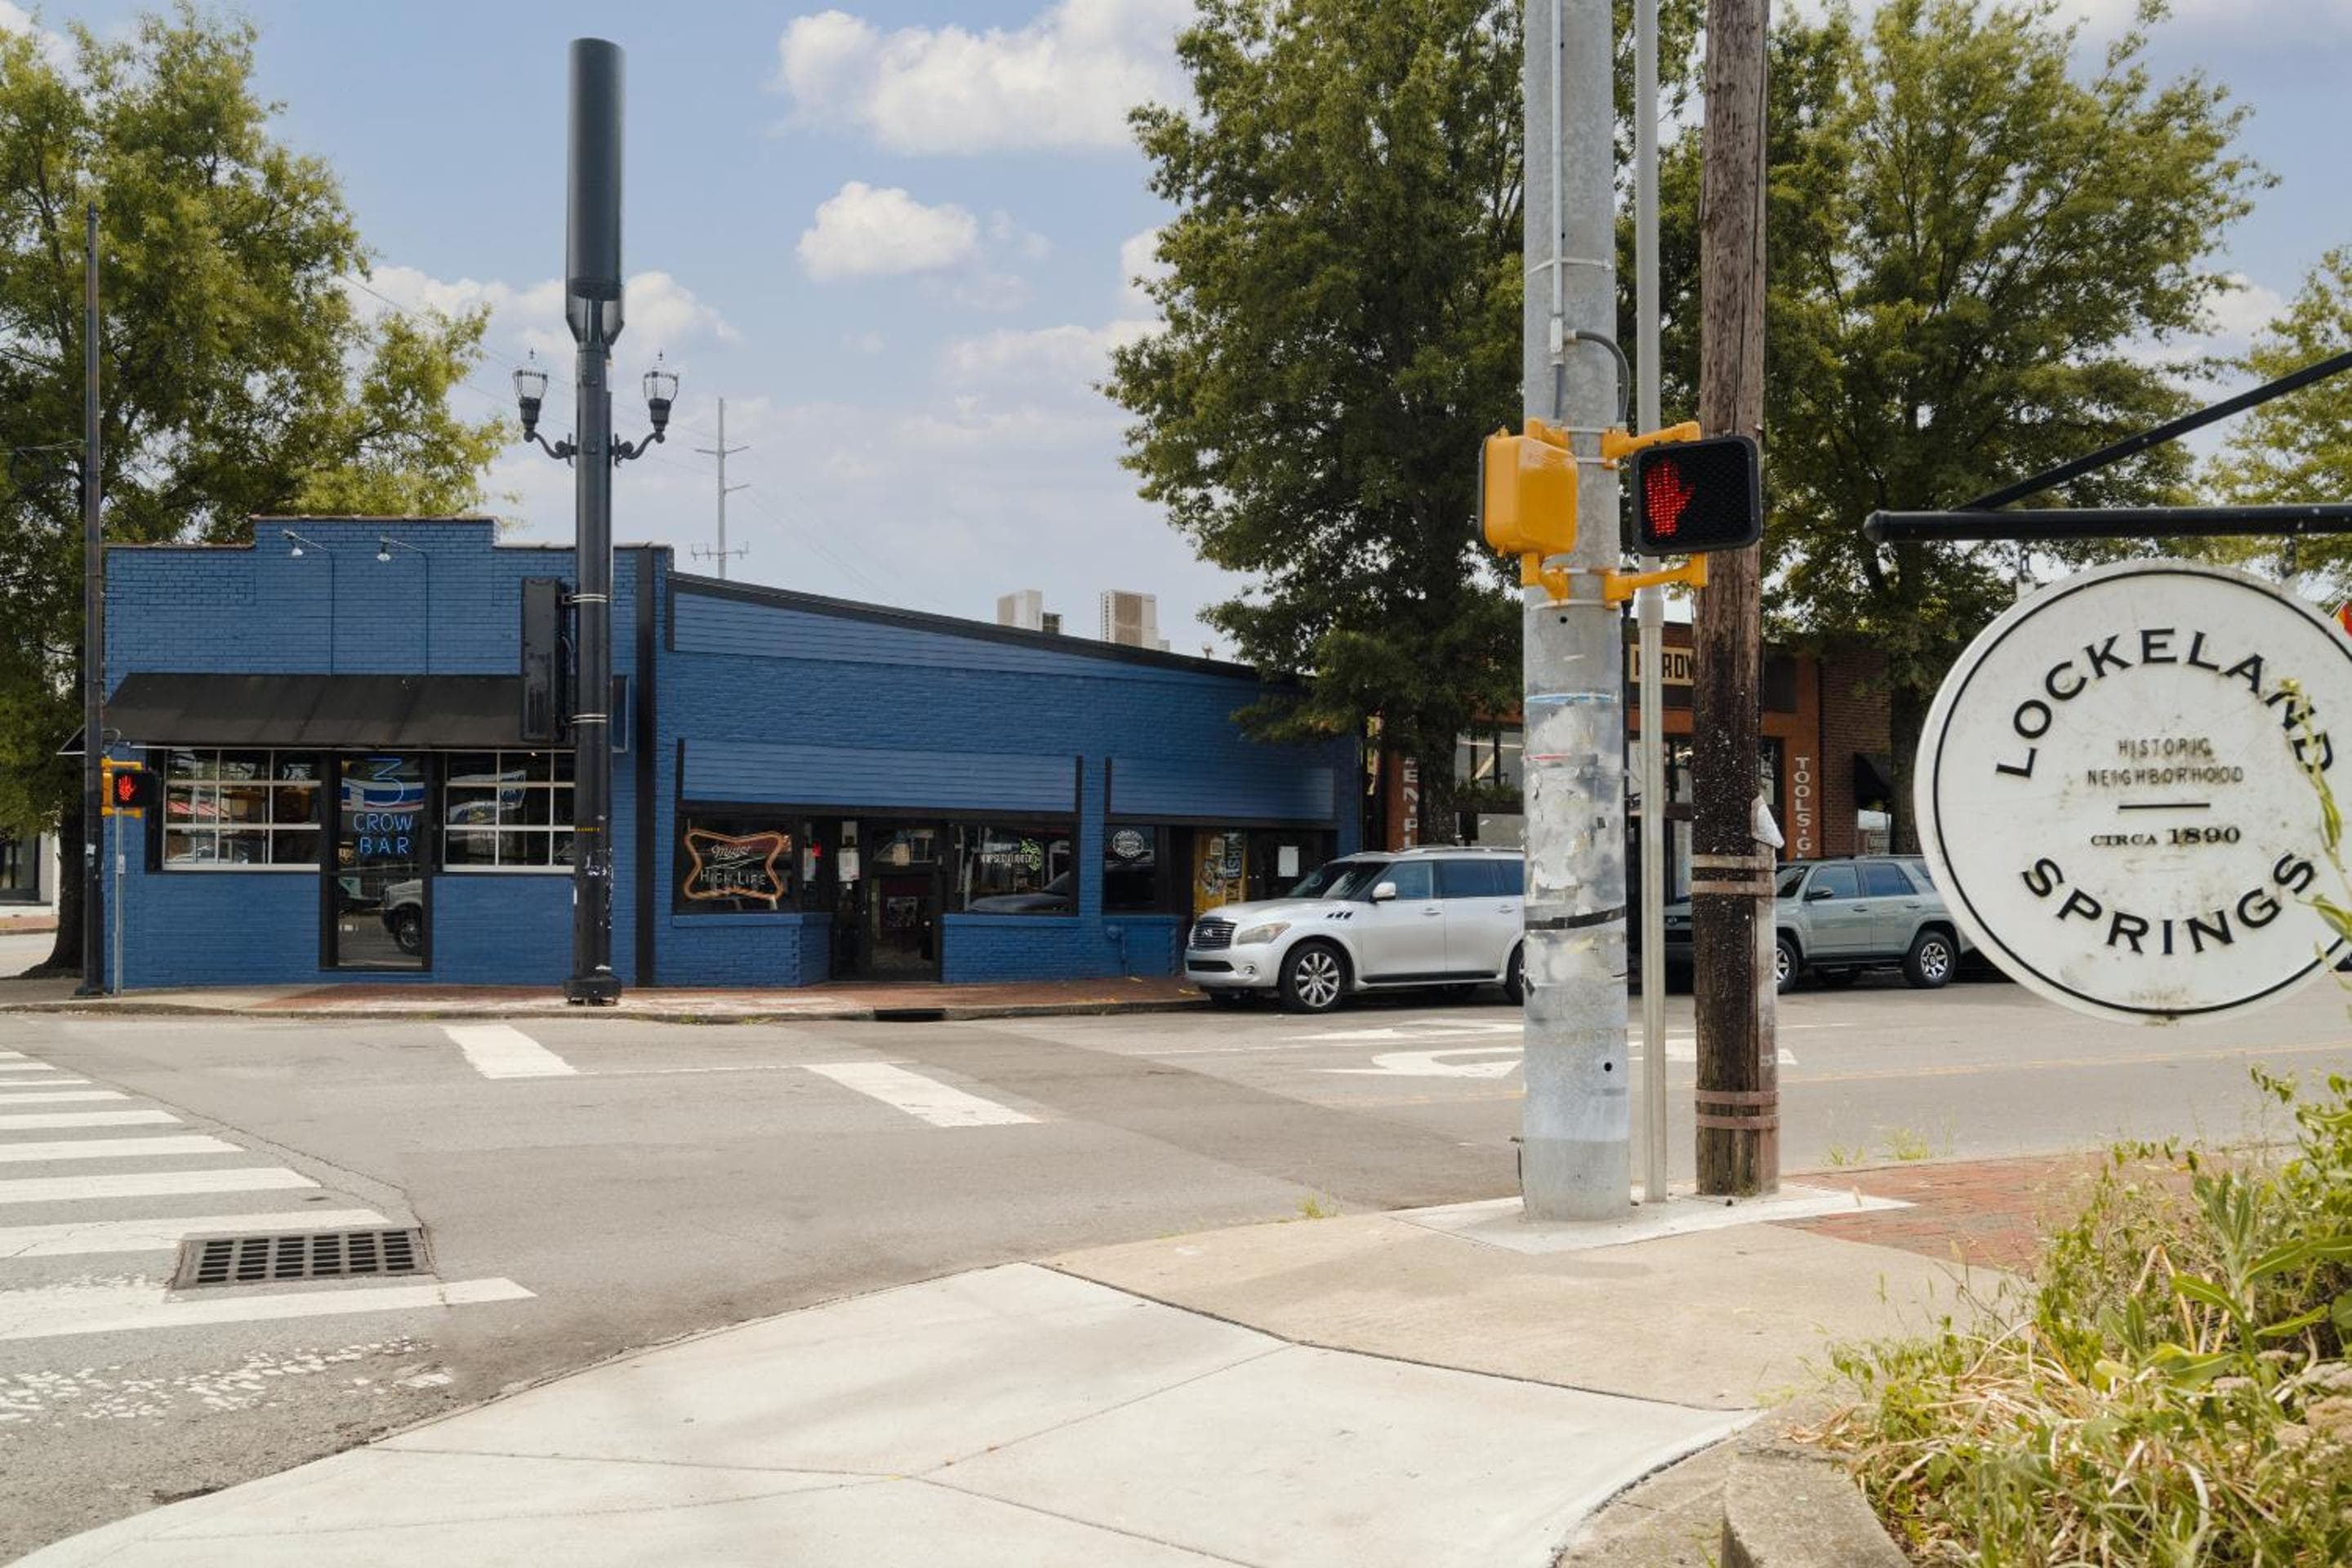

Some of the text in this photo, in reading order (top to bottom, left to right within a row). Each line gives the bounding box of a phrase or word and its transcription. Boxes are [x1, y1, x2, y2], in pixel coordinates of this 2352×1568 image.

[1996, 627, 2333, 779] LOCKELAND
[2118, 738, 2212, 757] HISTORIC
[2087, 766, 2244, 786] NEIGHBORHOOD
[353, 813, 414, 832] CROW
[359, 836, 409, 854] BAR
[2091, 826, 2242, 846] CIRCA 1890
[2022, 852, 2319, 956] SPRINGS
